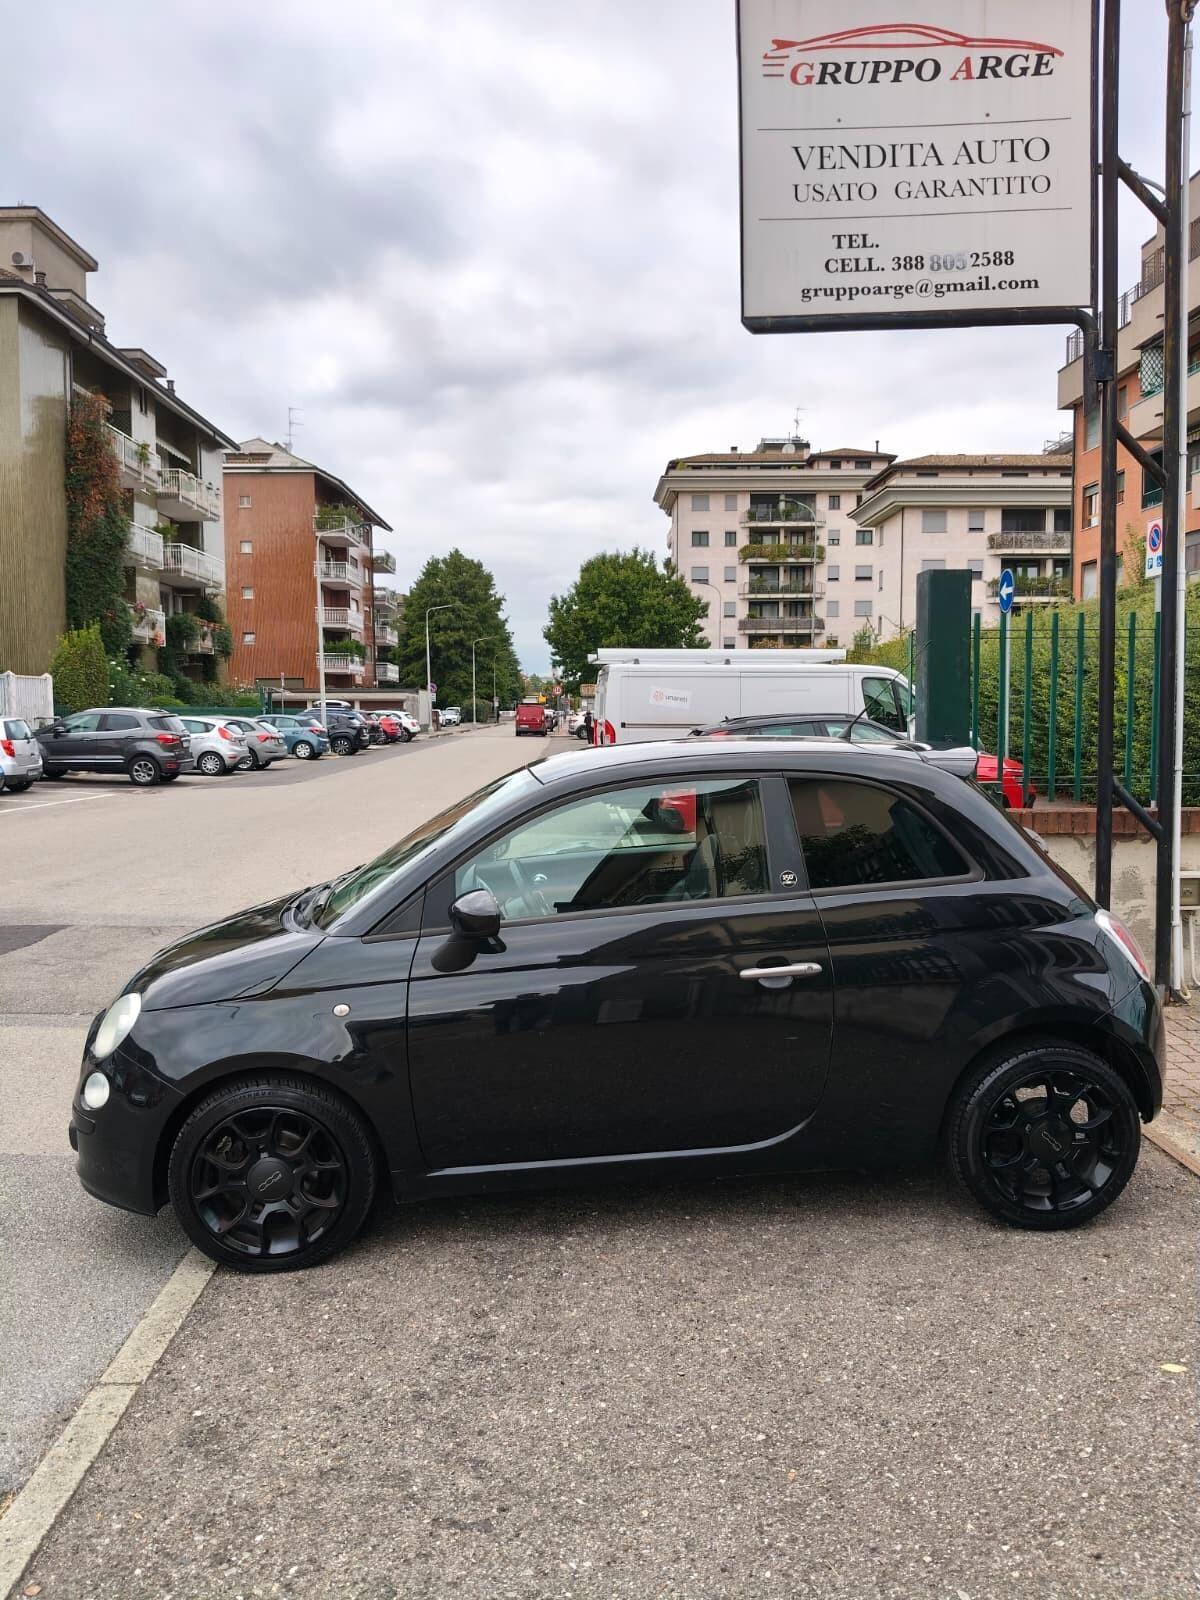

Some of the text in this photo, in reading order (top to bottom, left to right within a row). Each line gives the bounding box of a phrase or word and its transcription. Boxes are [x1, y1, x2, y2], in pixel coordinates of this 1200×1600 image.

[790, 52, 1055, 85] GRUPPO ARGE
[791, 136, 1050, 170] VENDITA AUTO
[791, 174, 1051, 203] USATO GARANTITO
[832, 233, 880, 249] TEL.
[824, 257, 885, 273] CELL.
[891, 255, 924, 271] 388
[970, 250, 1015, 267] 2588
[800, 275, 1040, 302] gruppoarge@gmail.com
